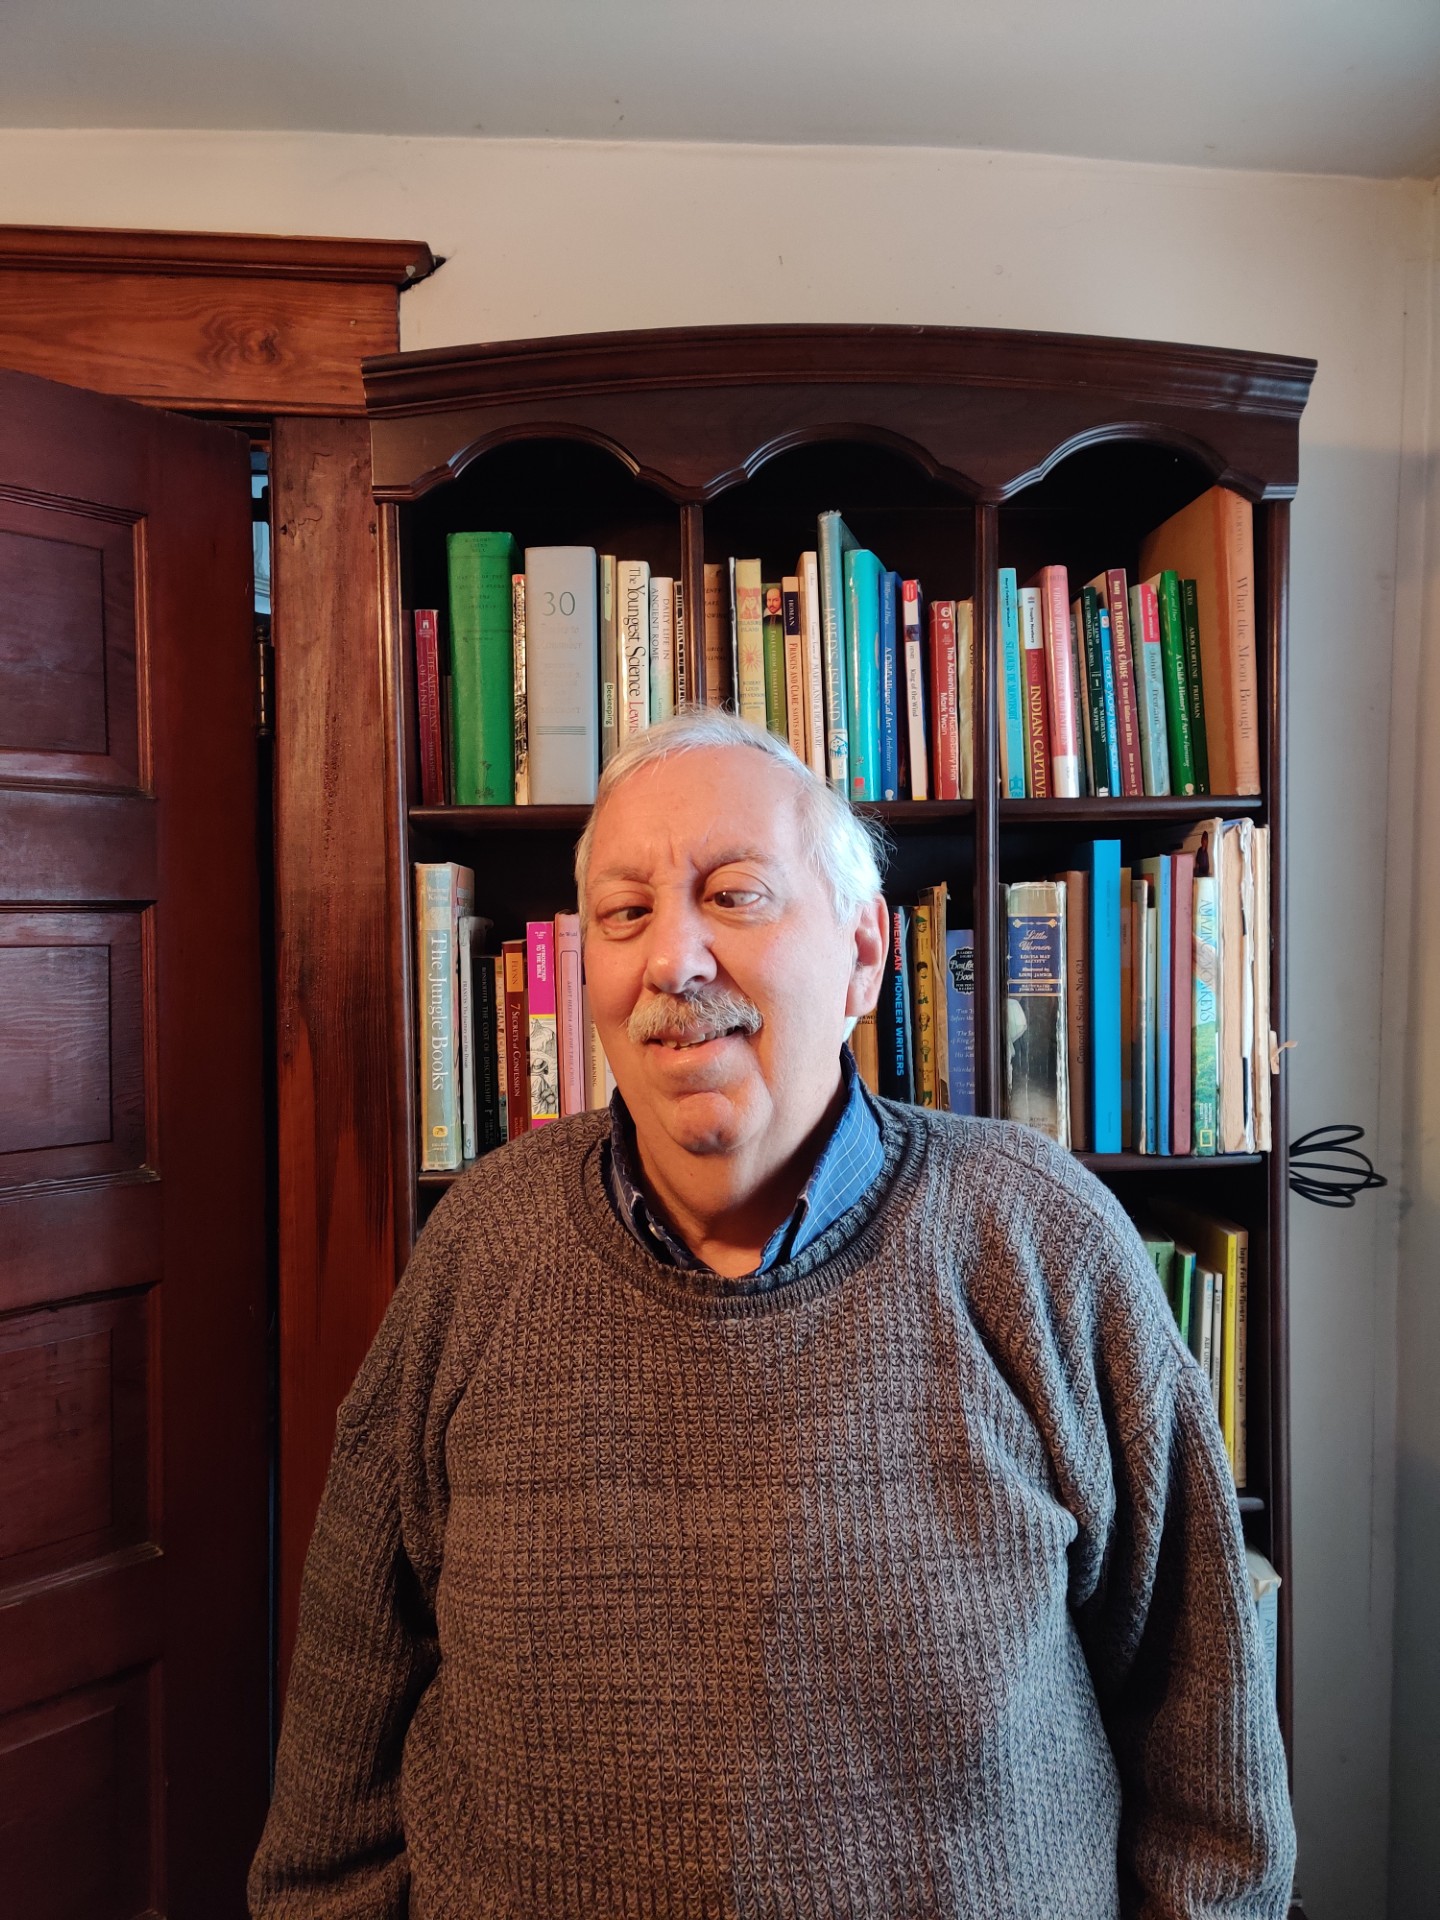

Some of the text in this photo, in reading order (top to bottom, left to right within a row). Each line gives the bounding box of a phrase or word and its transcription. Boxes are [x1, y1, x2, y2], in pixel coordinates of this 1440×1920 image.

[543, 591, 576, 617] 30
[787, 599, 796, 627] HOMAN
[651, 587, 662, 661] ANCIENT ROME
[662, 598, 672, 660] DAILY LIFE IN
[623, 567, 647, 734] The Youngest Science Lewis
[824, 607, 841, 722] JARED'S ISLAND
[1006, 650, 1016, 672] LOUIS
[1118, 654, 1129, 680] CAUSE
[1190, 646, 1198, 679] FORTUNE
[1236, 577, 1252, 740] What the Moon Brought
[772, 669, 781, 711] SHAKESPEARE
[788, 643, 802, 738] FRANCIS AND CLARE SAINTS OF
[811, 663, 820, 704] MARYLAND
[909, 669, 917, 682] King
[947, 662, 956, 706] Adventures
[1176, 661, 1185, 685] Child's
[419, 664, 431, 720] OF VENICE
[425, 650, 438, 734] THE MERCHANT
[606, 684, 614, 725] Beekeeping
[884, 646, 895, 773] A Child's History of Art Architecture
[910, 691, 918, 701] the
[910, 701, 919, 718] Wind
[1007, 684, 1018, 721] MONTFORT
[1178, 685, 1187, 713] History
[1192, 685, 1200, 702] FREE
[813, 710, 823, 749] DELAWARE
[940, 692, 949, 736] Mark Twain
[948, 707, 957, 716] of
[1030, 685, 1043, 737] INDIAN
[1180, 713, 1188, 722] of
[1181, 722, 1189, 735] Art
[949, 716, 958, 764] Huckleberry
[950, 764, 958, 781] Finn
[1033, 739, 1047, 799] CAPTIVE
[1024, 930, 1048, 940] Little
[1198, 899, 1213, 953] AMAZING
[1018, 941, 1052, 951] Women
[511, 960, 519, 985] FLYNN
[427, 933, 449, 1092] The Jungle Books
[893, 912, 905, 1076] AMERICAN PIONEER WRITERS
[1075, 959, 1085, 1064] Concord Series No 621
[482, 1022, 490, 1041] COST
[497, 1004, 505, 1031] THAN
[511, 1010, 520, 1042] SECRETS
[483, 1042, 490, 1053] OF
[591, 1044, 596, 1054] OF
[483, 1056, 492, 1104] DISCIPLESHIP
[498, 1040, 507, 1093] CARPENTER
[512, 1050, 522, 1097] CONFESSION
[1238, 1247, 1247, 1264] hope
[1239, 1295, 1247, 1323] flowers
